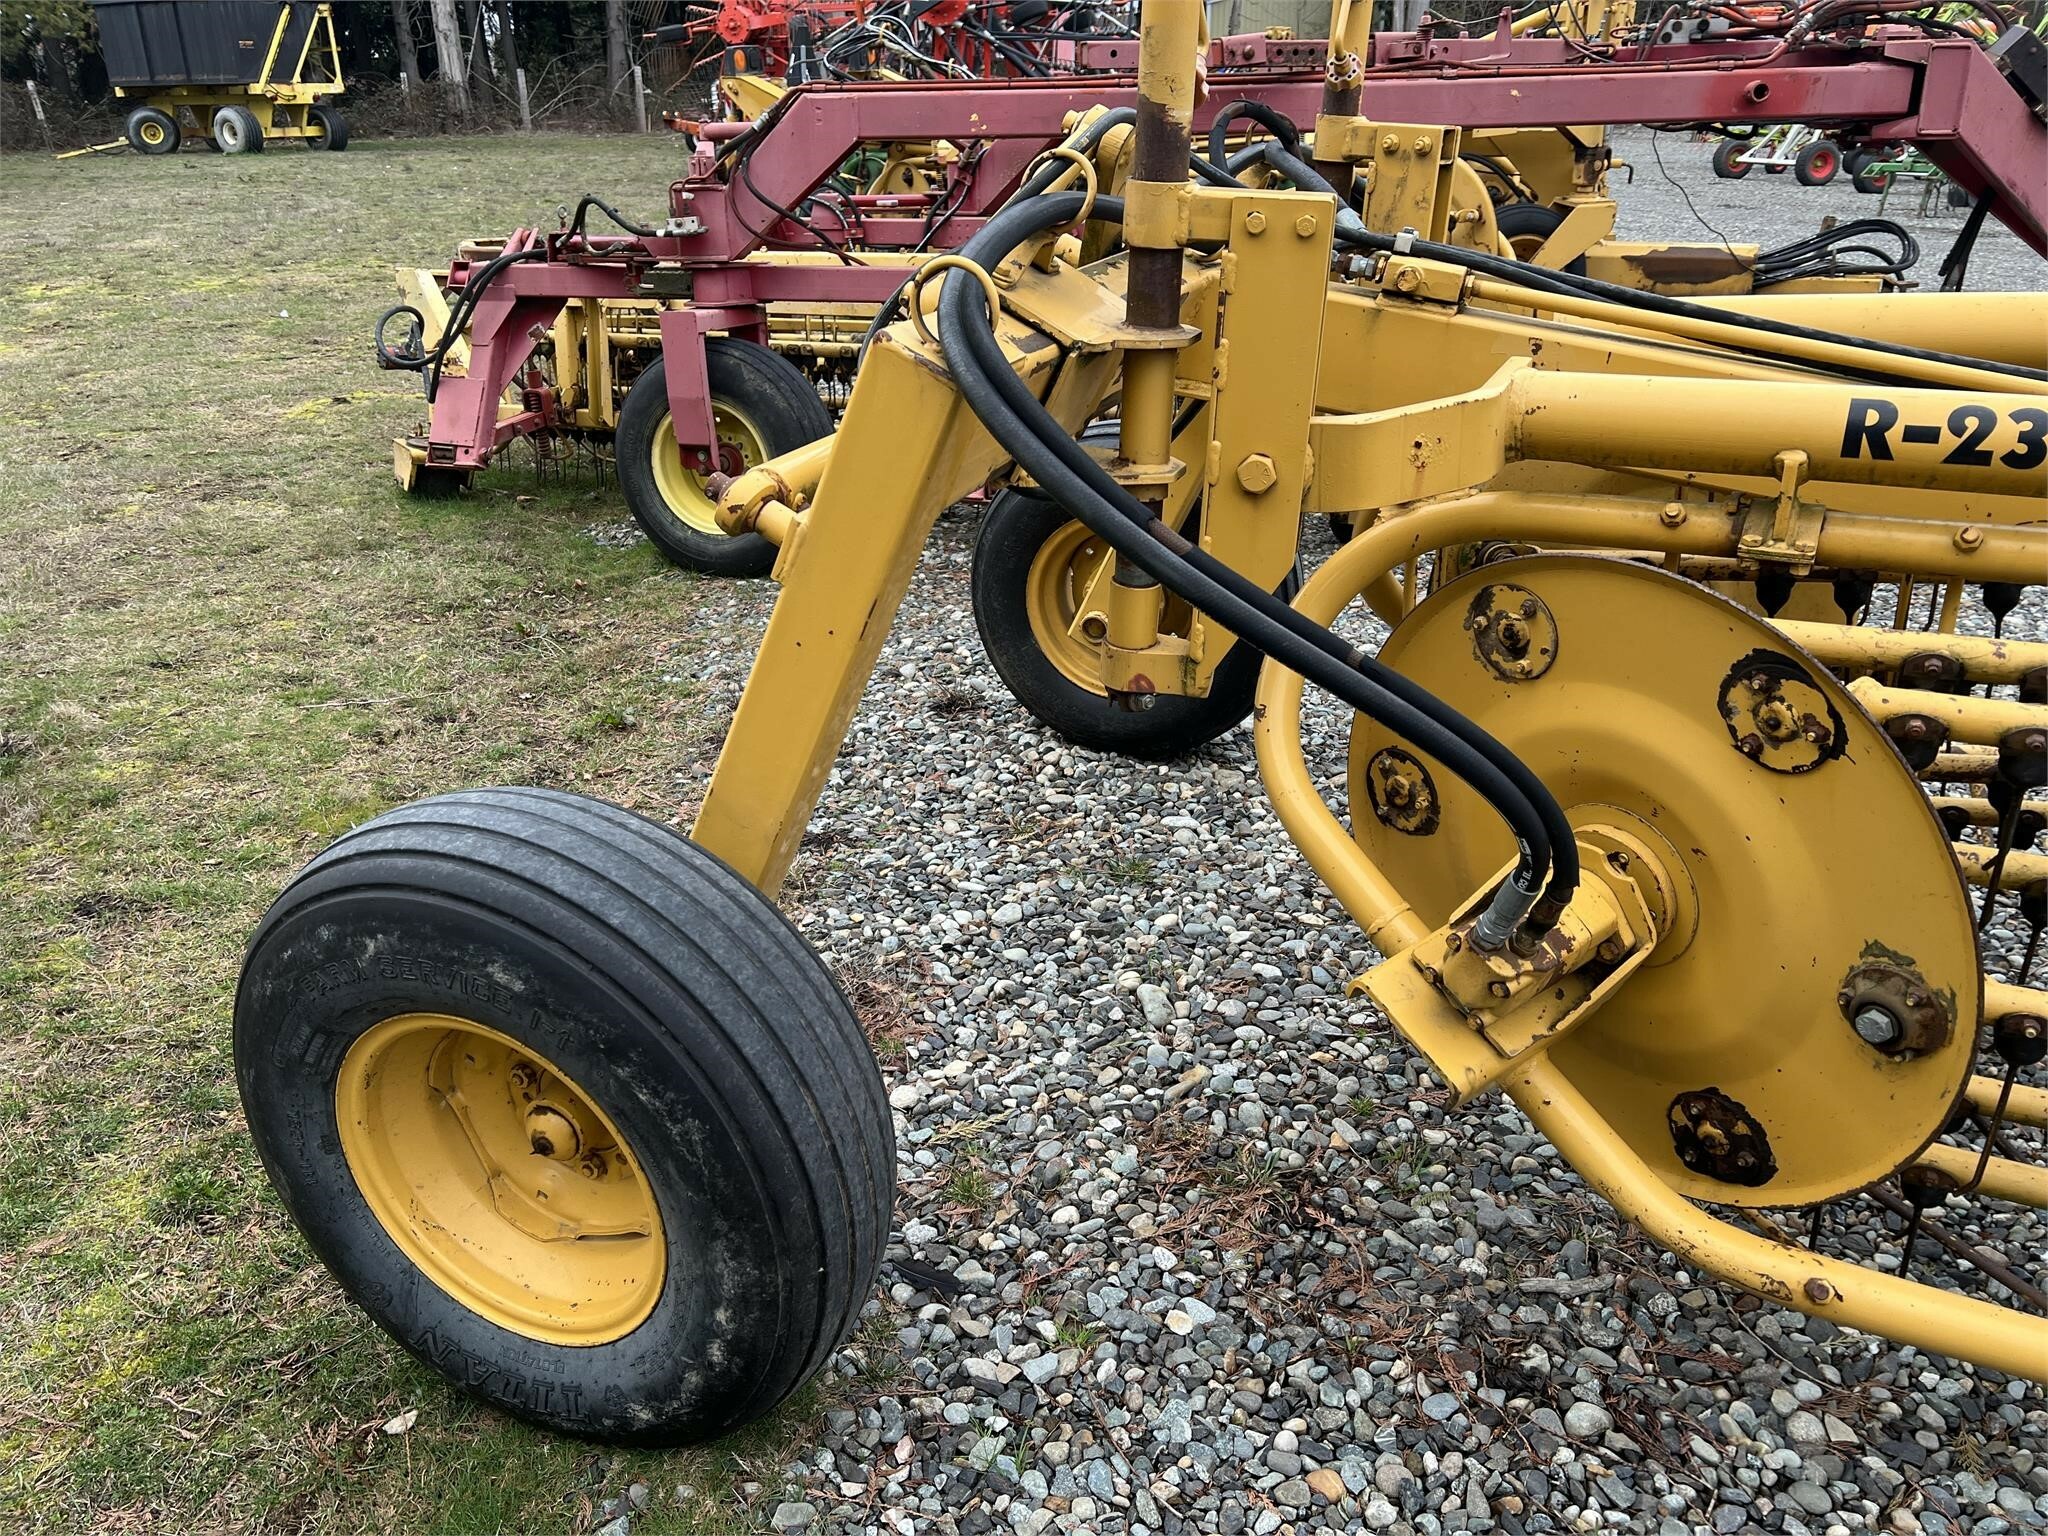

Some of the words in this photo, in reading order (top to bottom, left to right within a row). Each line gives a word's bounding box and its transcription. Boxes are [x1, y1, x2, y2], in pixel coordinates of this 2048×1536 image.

[1840, 398, 2047, 470] R-23
[301, 959, 369, 995] FARM
[376, 954, 514, 1014] SERVICE
[408, 1327, 592, 1425] TITAN
